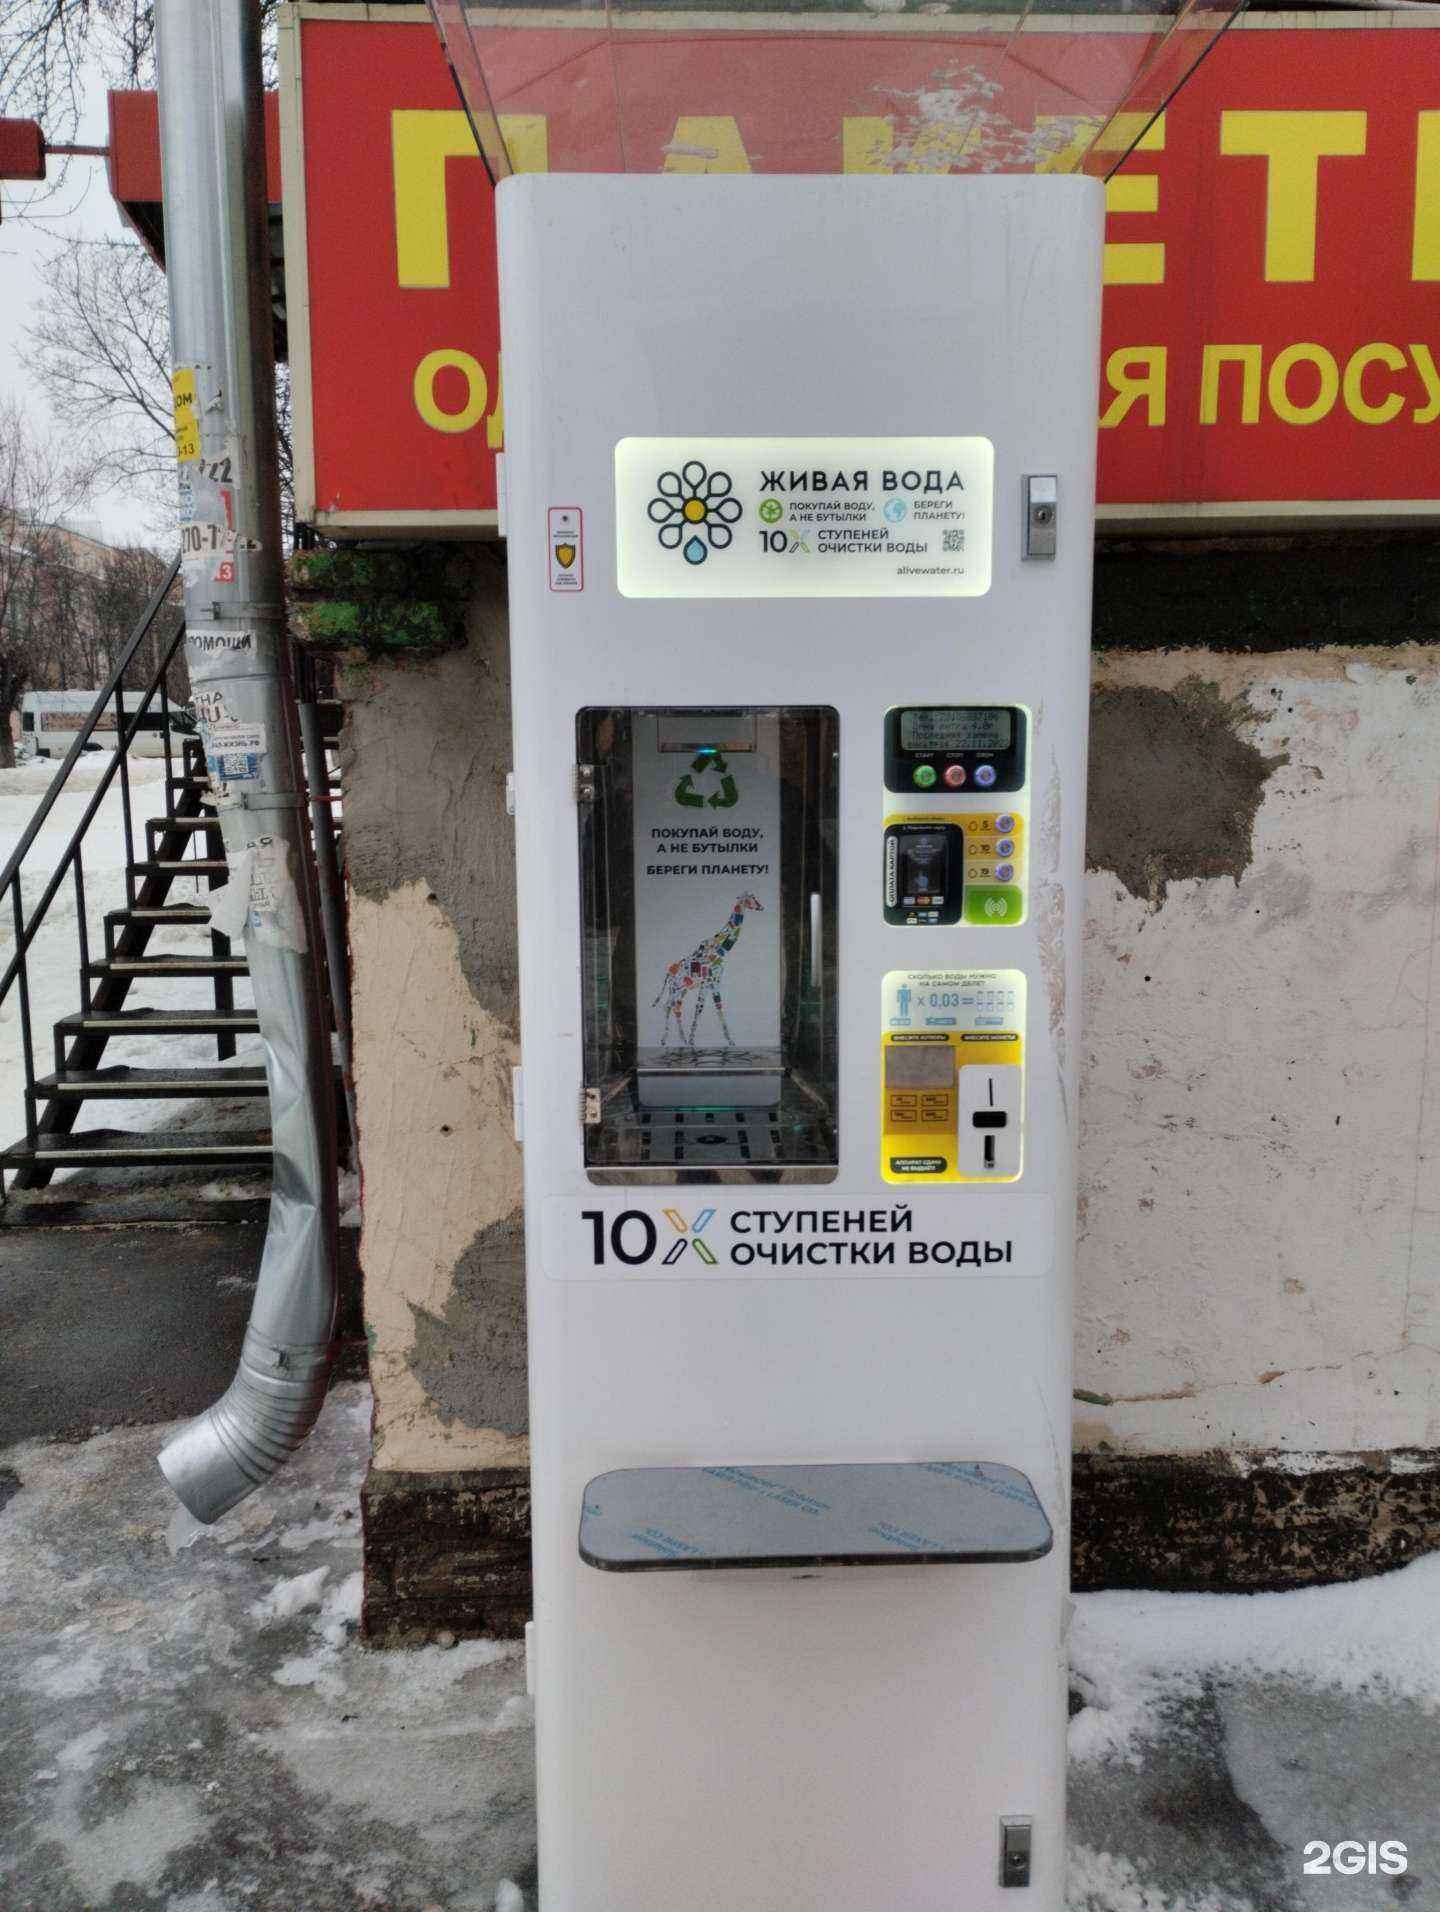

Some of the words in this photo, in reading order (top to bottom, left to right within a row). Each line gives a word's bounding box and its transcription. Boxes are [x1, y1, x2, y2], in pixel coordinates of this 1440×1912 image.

[760, 470, 868, 492] ЖИВАЯ
[882, 470, 964, 494] ВОДА
[789, 501, 842, 511] ПОКУПАЙ
[844, 502, 875, 512] ВОДУ,
[913, 501, 953, 509] БЕРЕГИ
[789, 513, 797, 522] А
[816, 513, 867, 522] БУТЫЛКИ
[913, 511, 965, 520] ПЛАНЕТУ!
[818, 528, 889, 540] СТУПЕНЕЙ
[818, 543, 882, 553] ОЧИСТКИ
[887, 543, 928, 555] ВОДЫ
[897, 566, 965, 576] alivewater.ru
[651, 827, 719, 839] ПОКУПАЙ
[723, 828, 764, 839] ВОДУ,
[657, 844, 666, 853] А
[670, 844, 688, 853] НЕ
[692, 844, 758, 853] БУТЫЛКИ
[647, 865, 698, 875] БЕРЕГИ
[702, 864, 769, 875] ПЛАНЕТУ!
[730, 1205, 913, 1233] СТУПЕНЕЙ
[730, 1242, 895, 1265] ОЧИСТКИ
[909, 1241, 1012, 1267] ВОДЫ
